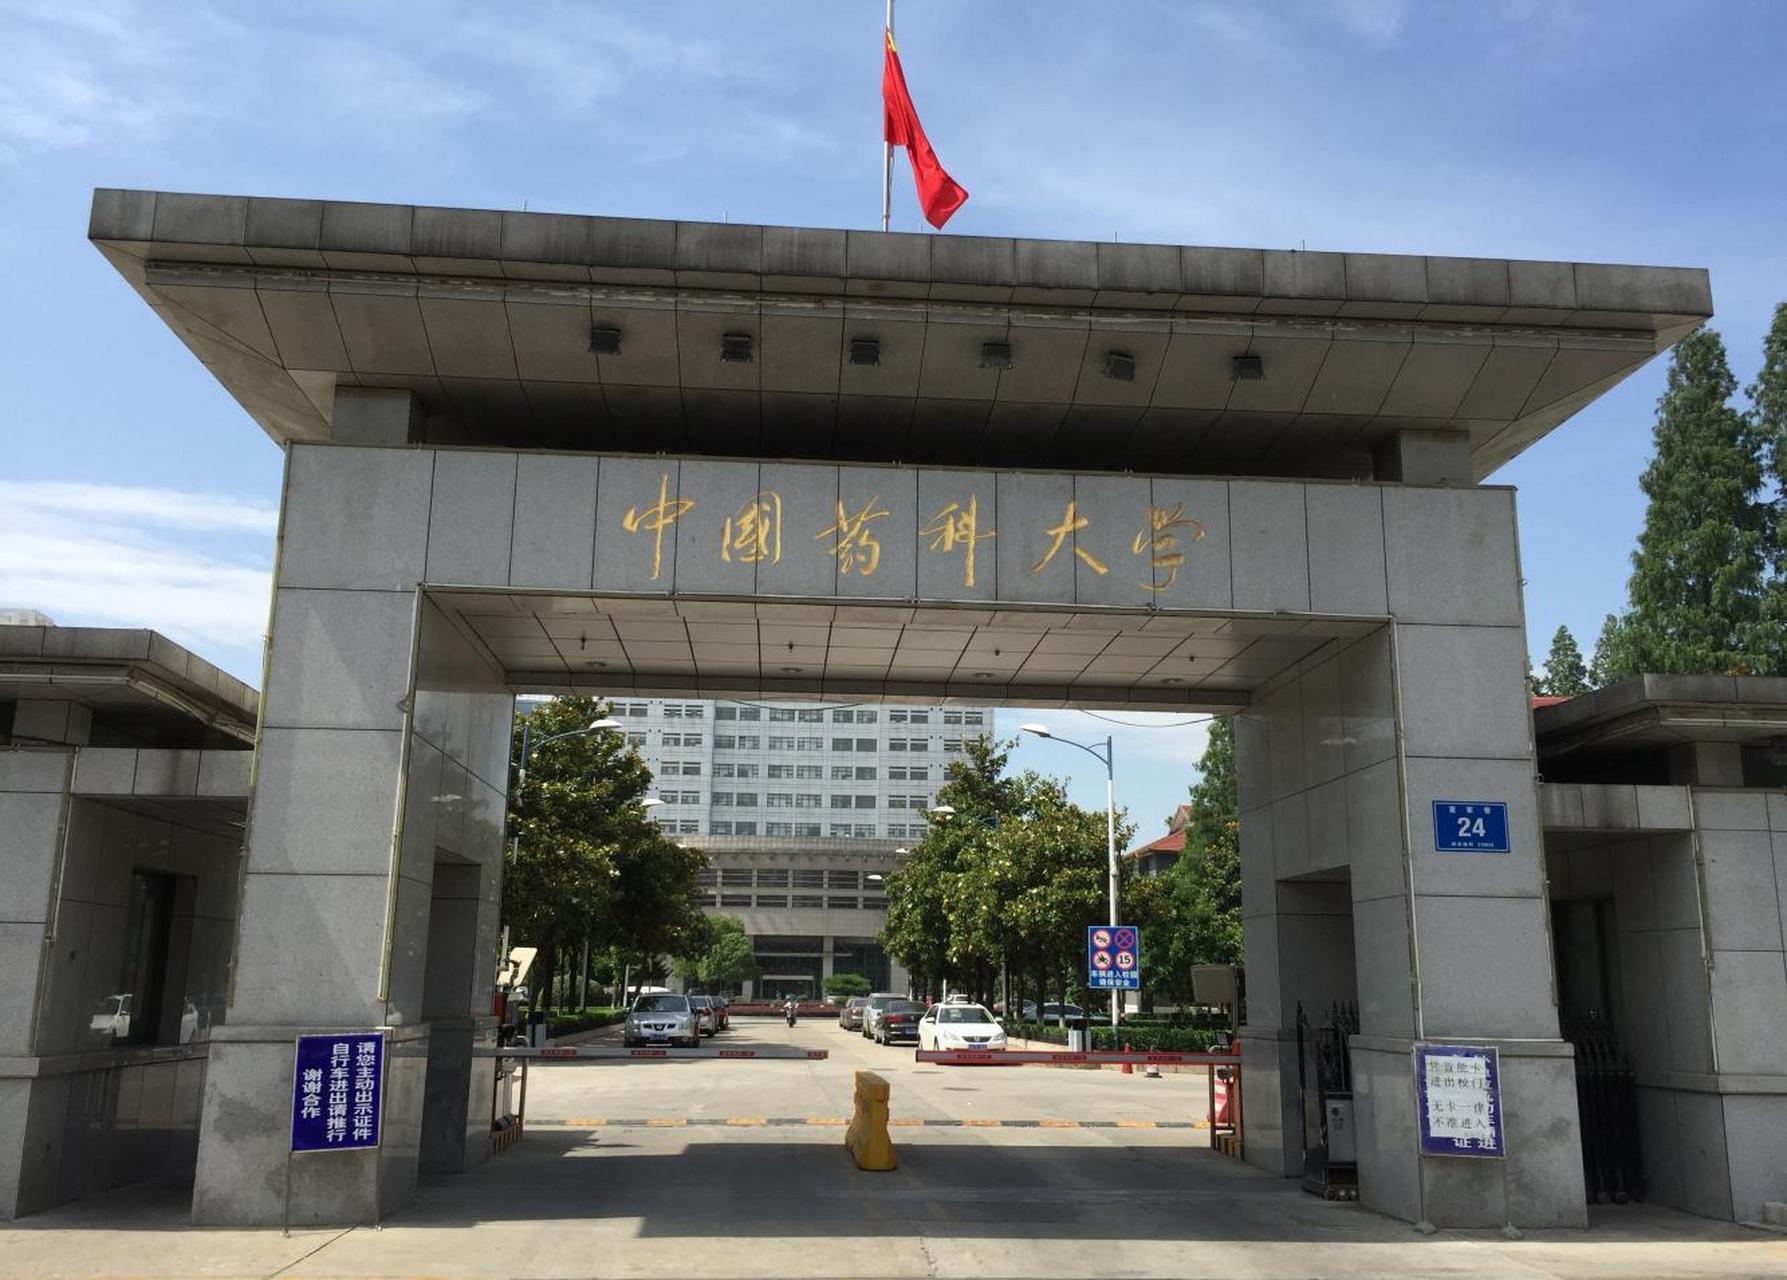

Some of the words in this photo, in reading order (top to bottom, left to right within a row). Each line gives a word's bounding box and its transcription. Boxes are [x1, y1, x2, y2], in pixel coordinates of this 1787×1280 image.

[1457, 817, 1486, 838] 24
[1120, 955, 1131, 964] 15
[352, 1041, 376, 1141] 请您主动出示证件
[1430, 1077, 1483, 1089] 进出校门
[301, 1068, 323, 1119] 谢谢合作
[326, 1043, 351, 1142] 自行车进出请推行
[1433, 1101, 1485, 1114] 无卡一律
[1434, 1117, 1486, 1130] 不准进入
